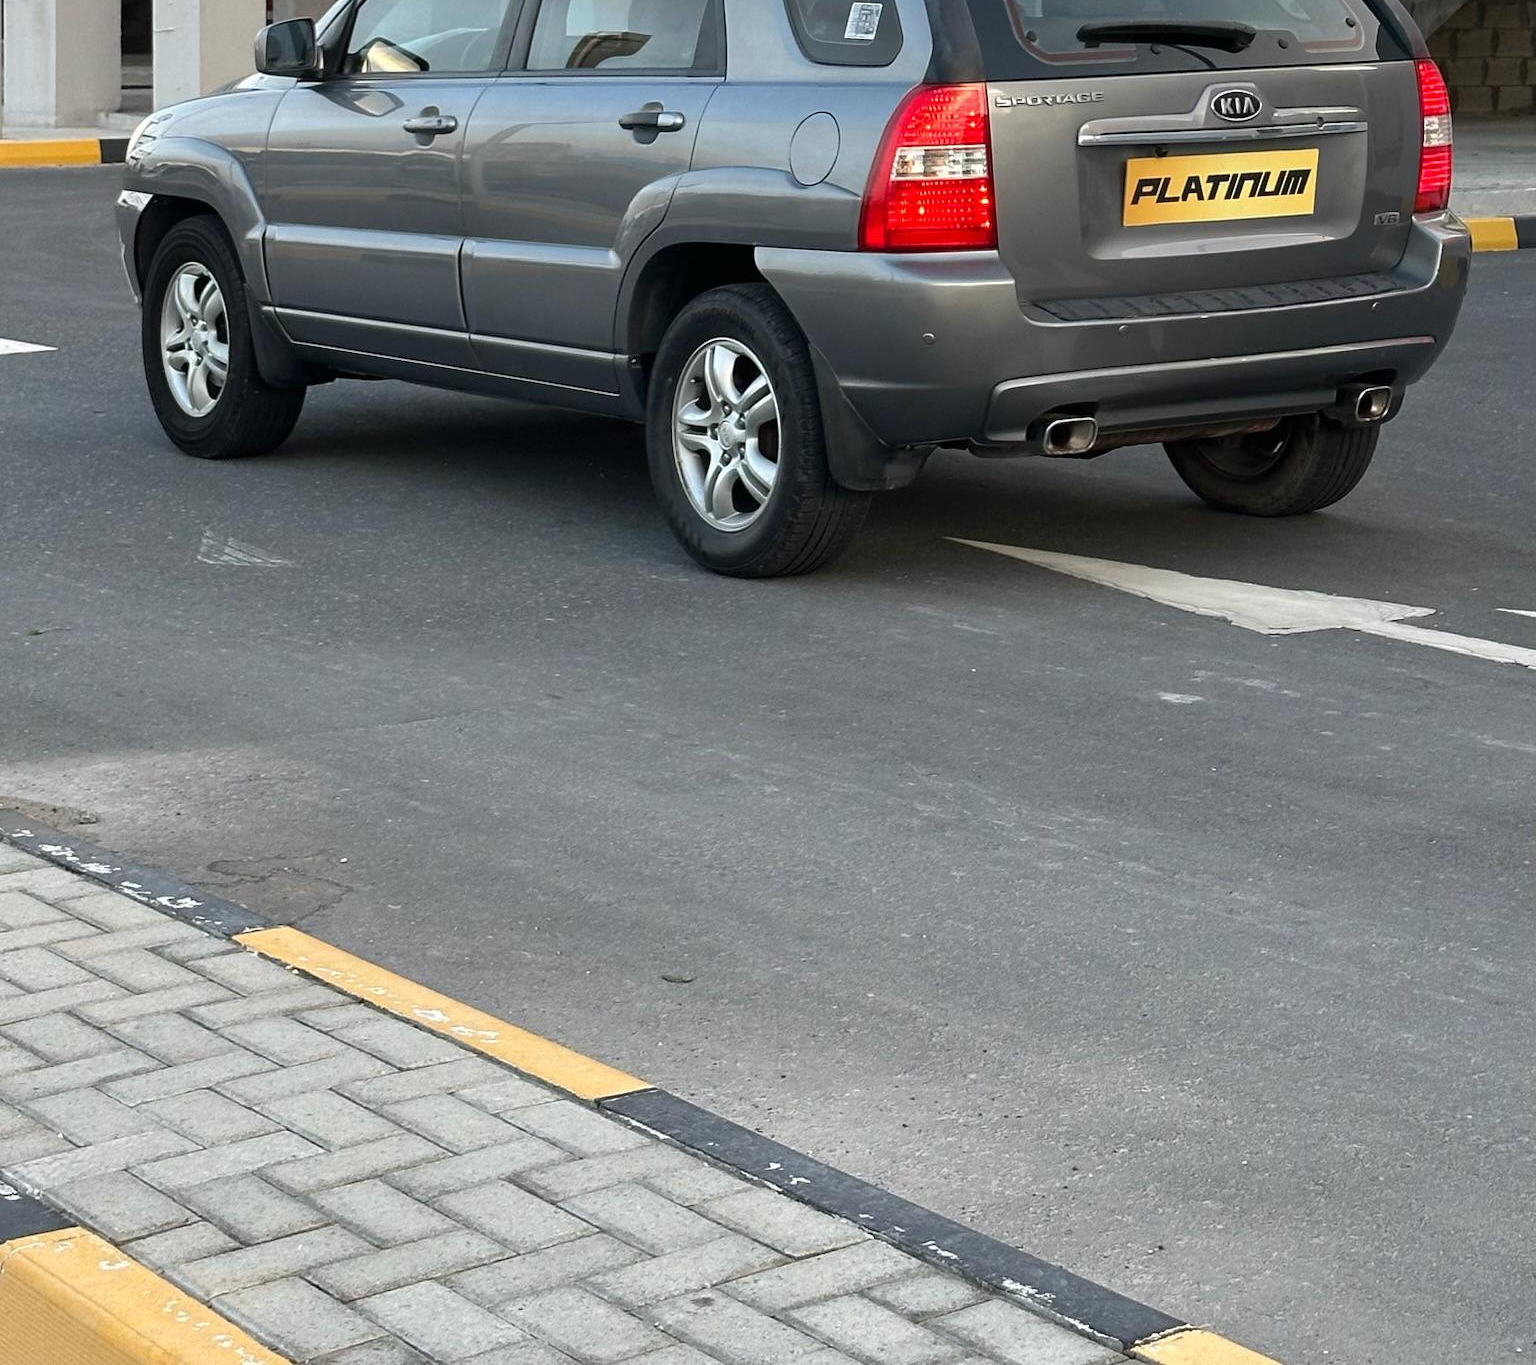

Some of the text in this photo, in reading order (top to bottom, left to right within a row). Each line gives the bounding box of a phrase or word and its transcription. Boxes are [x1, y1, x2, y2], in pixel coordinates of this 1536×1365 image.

[995, 91, 1105, 108] SPORTAGE
[1220, 96, 1256, 115] KIA
[1130, 169, 1312, 205] PLATINUM
